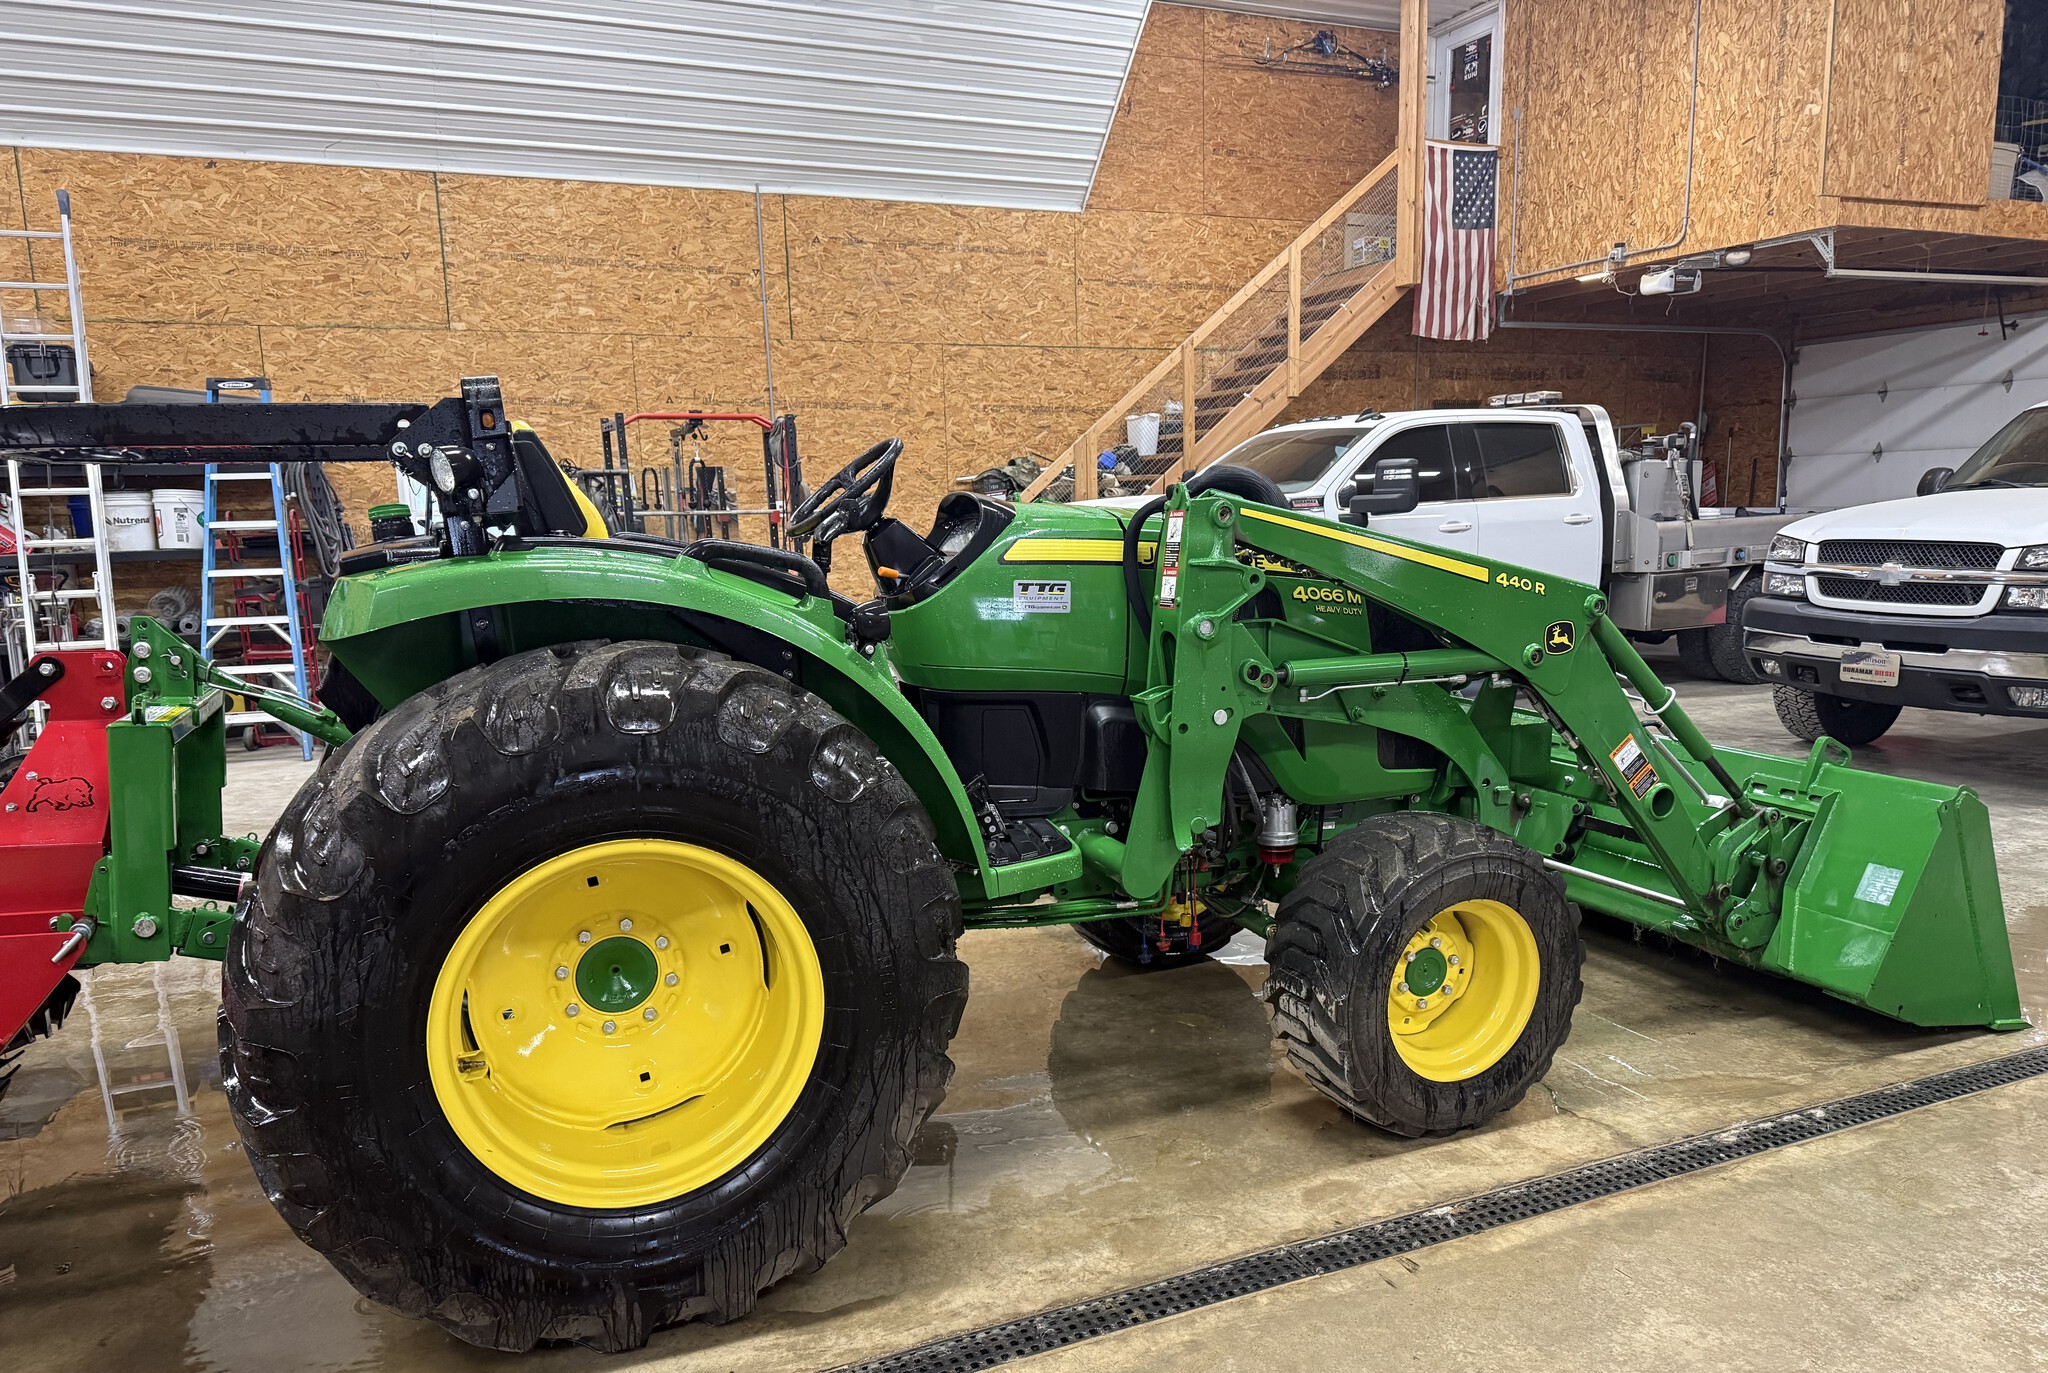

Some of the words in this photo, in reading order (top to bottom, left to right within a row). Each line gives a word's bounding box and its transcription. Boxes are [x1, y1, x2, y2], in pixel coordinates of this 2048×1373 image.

[1017, 582, 1067, 596] TTG
[1495, 572, 1533, 591] 440
[1535, 581, 1546, 596] R
[1292, 585, 1345, 603] 4066
[1346, 590, 1362, 604] M
[1315, 605, 1341, 613] HEAVY
[1343, 607, 1363, 615] DUTY
[1842, 666, 1873, 676] DURAMAX
[1874, 669, 1896, 678] DIESEL
